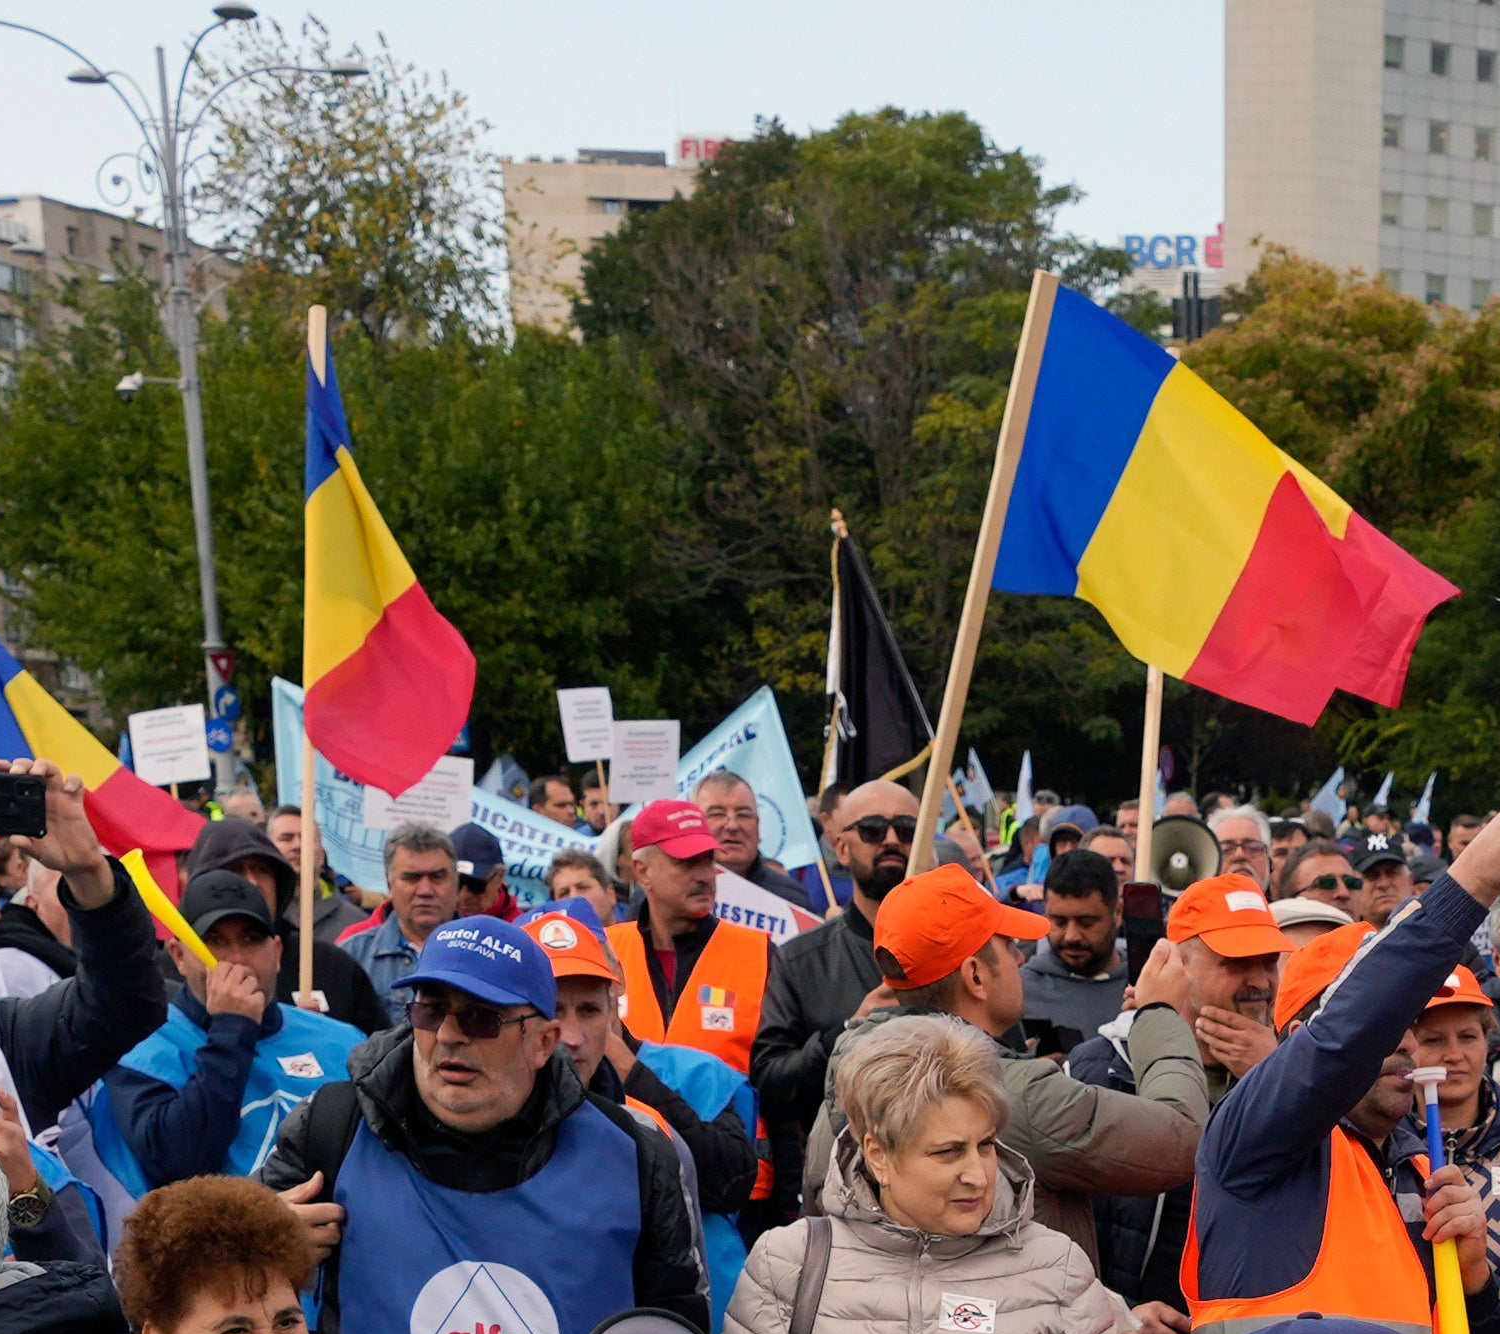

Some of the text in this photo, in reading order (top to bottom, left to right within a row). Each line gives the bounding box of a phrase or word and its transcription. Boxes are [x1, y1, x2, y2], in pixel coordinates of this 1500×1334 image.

[1126, 234, 1197, 268] BCR
[447, 939, 496, 961] SUCEAVA
[481, 935, 522, 963] ALFA
